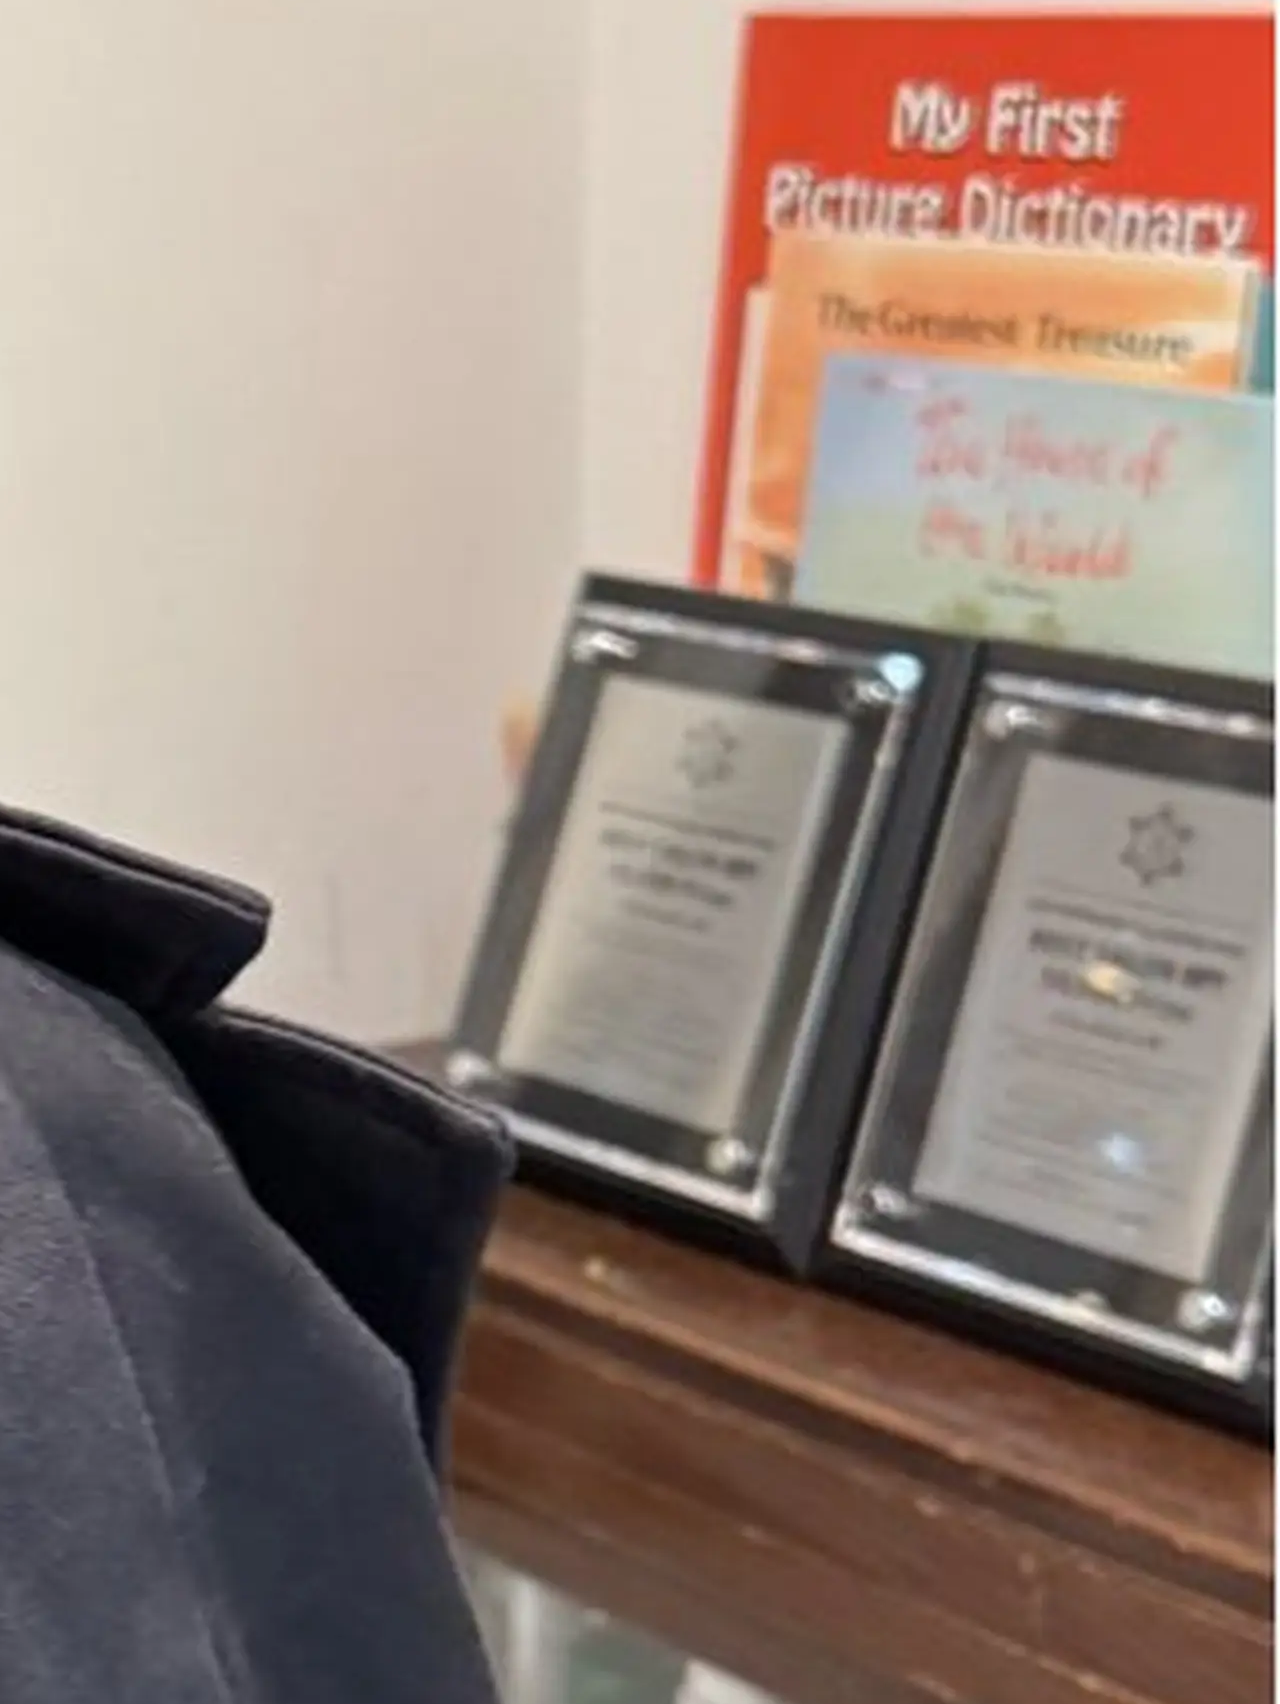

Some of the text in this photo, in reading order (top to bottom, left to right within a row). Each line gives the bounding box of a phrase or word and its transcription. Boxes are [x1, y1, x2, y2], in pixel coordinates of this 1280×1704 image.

[888, 79, 1127, 163] My First
[763, 162, 1252, 259] Picture Dictionary
[817, 292, 1195, 365] The Greatest Treasure
